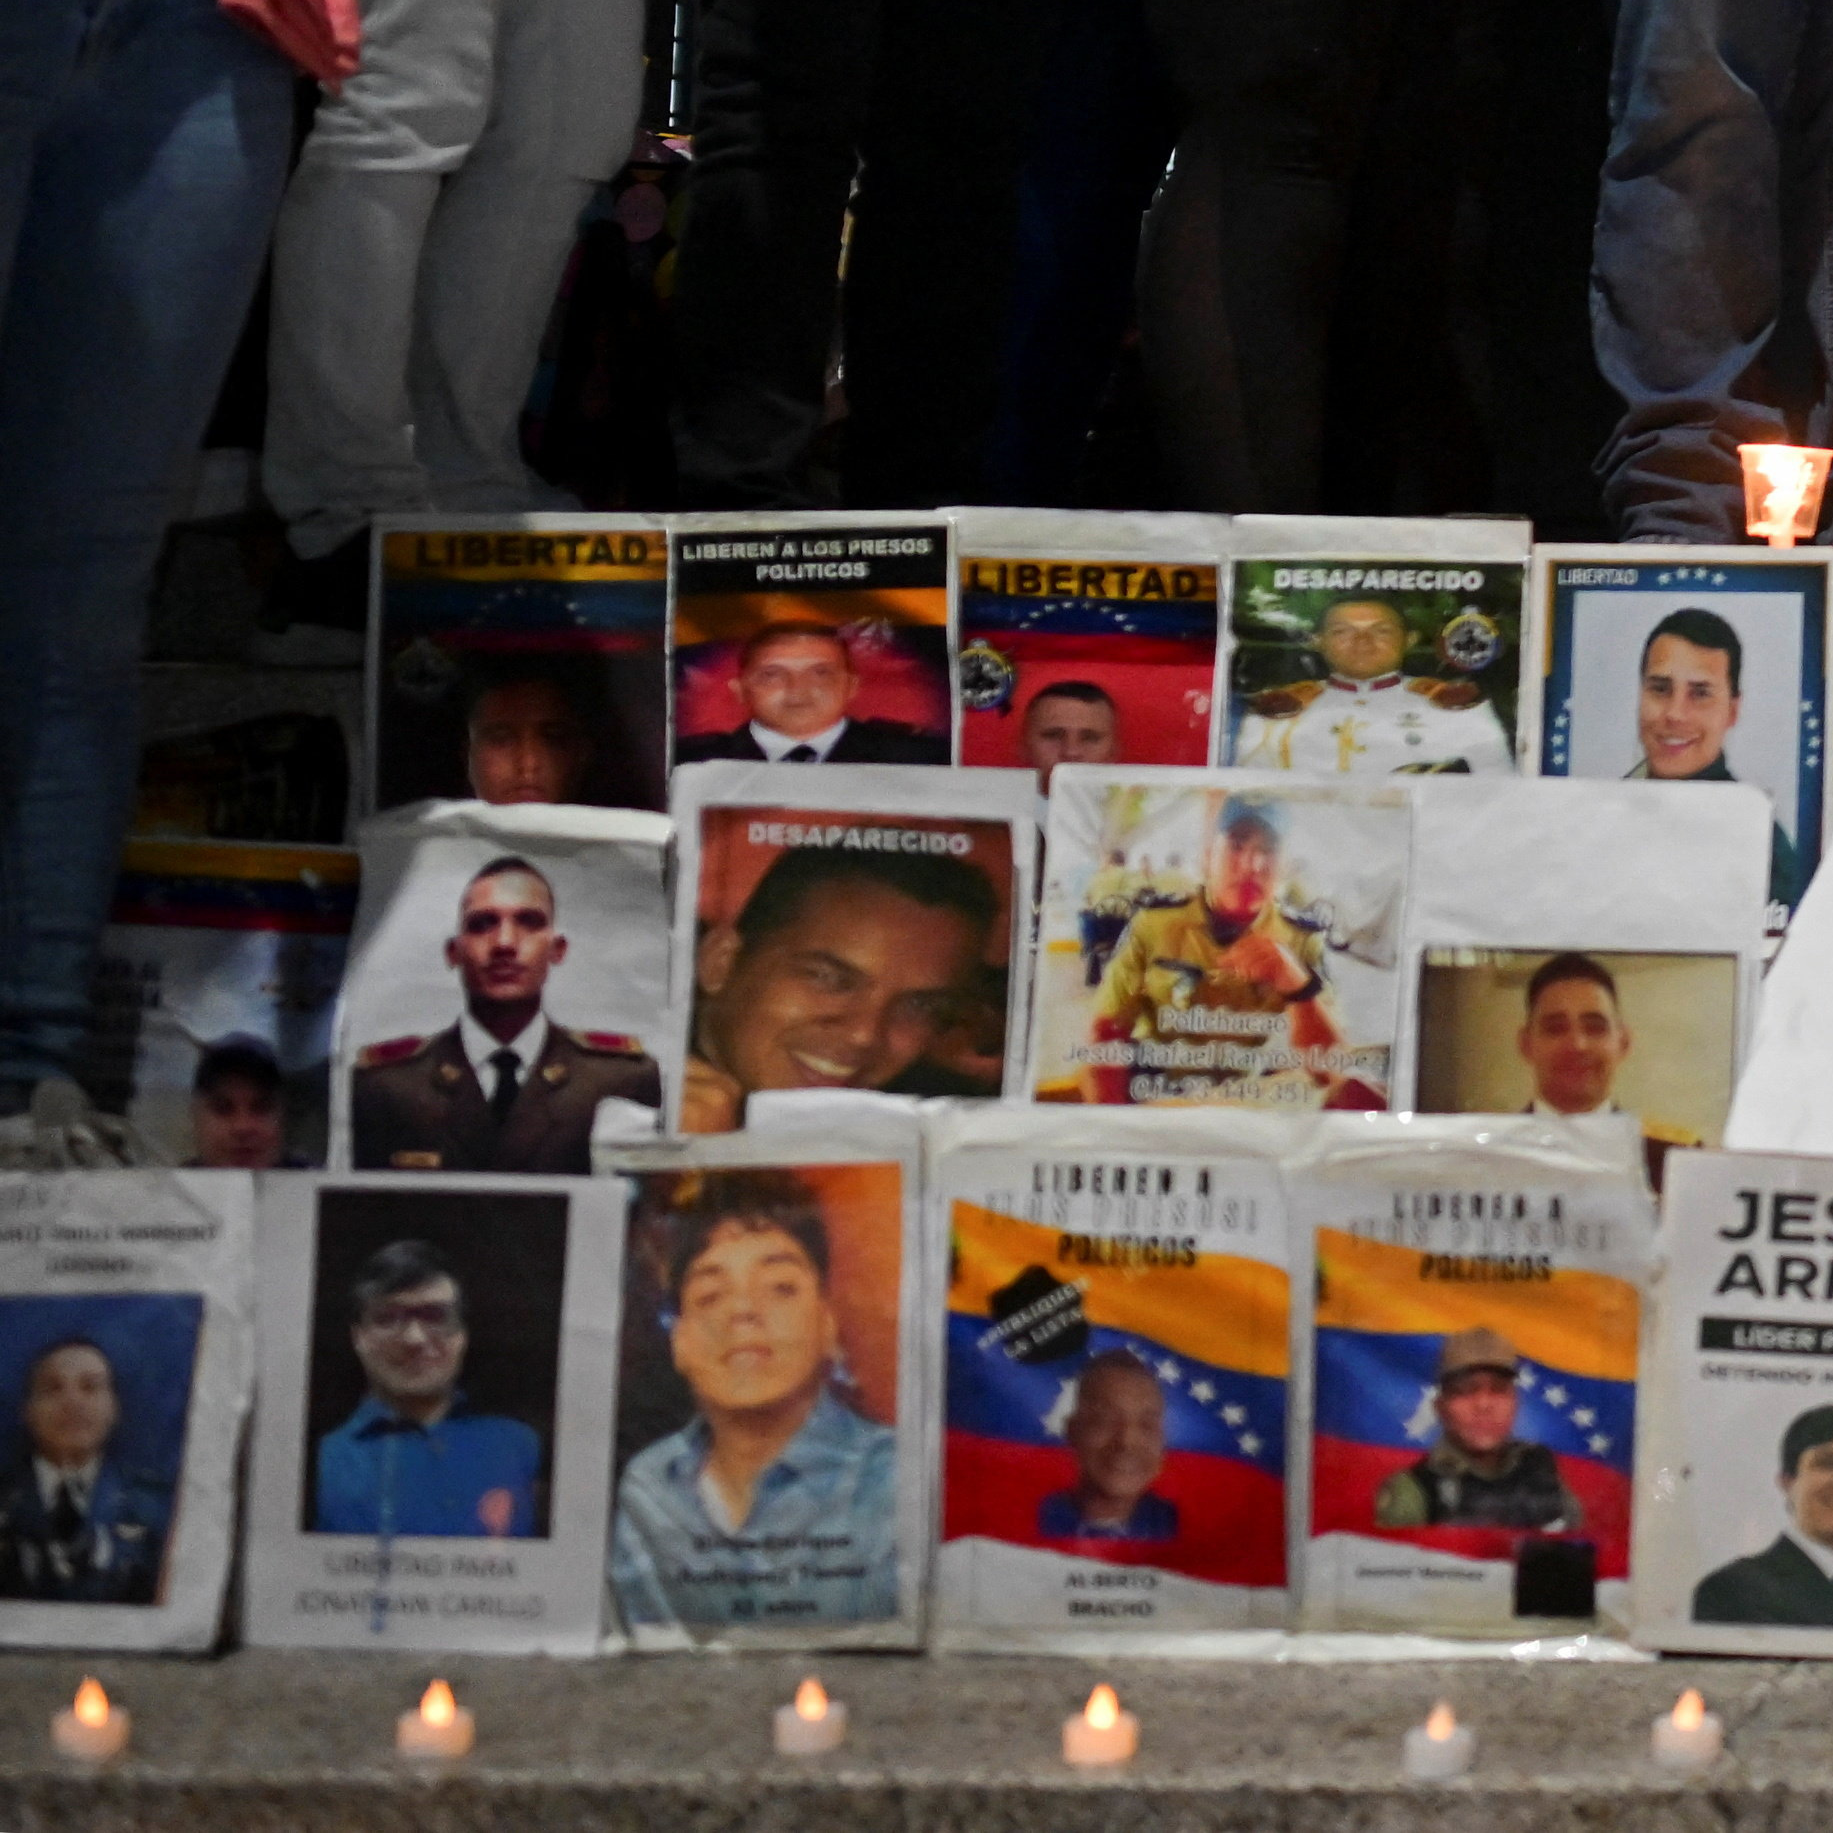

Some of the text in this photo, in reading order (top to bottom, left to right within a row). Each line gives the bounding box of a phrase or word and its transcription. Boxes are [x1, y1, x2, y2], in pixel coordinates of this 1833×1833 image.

[417, 534, 648, 566] LIBERTAD
[683, 538, 931, 561] LIBEREN A LOS PRESOS
[969, 565, 1200, 599] LIBERTAD
[1274, 569, 1485, 592] DESAPARECIDO
[1558, 569, 1638, 585] LIBERTAD
[747, 821, 974, 857] DESAPARECIDO
